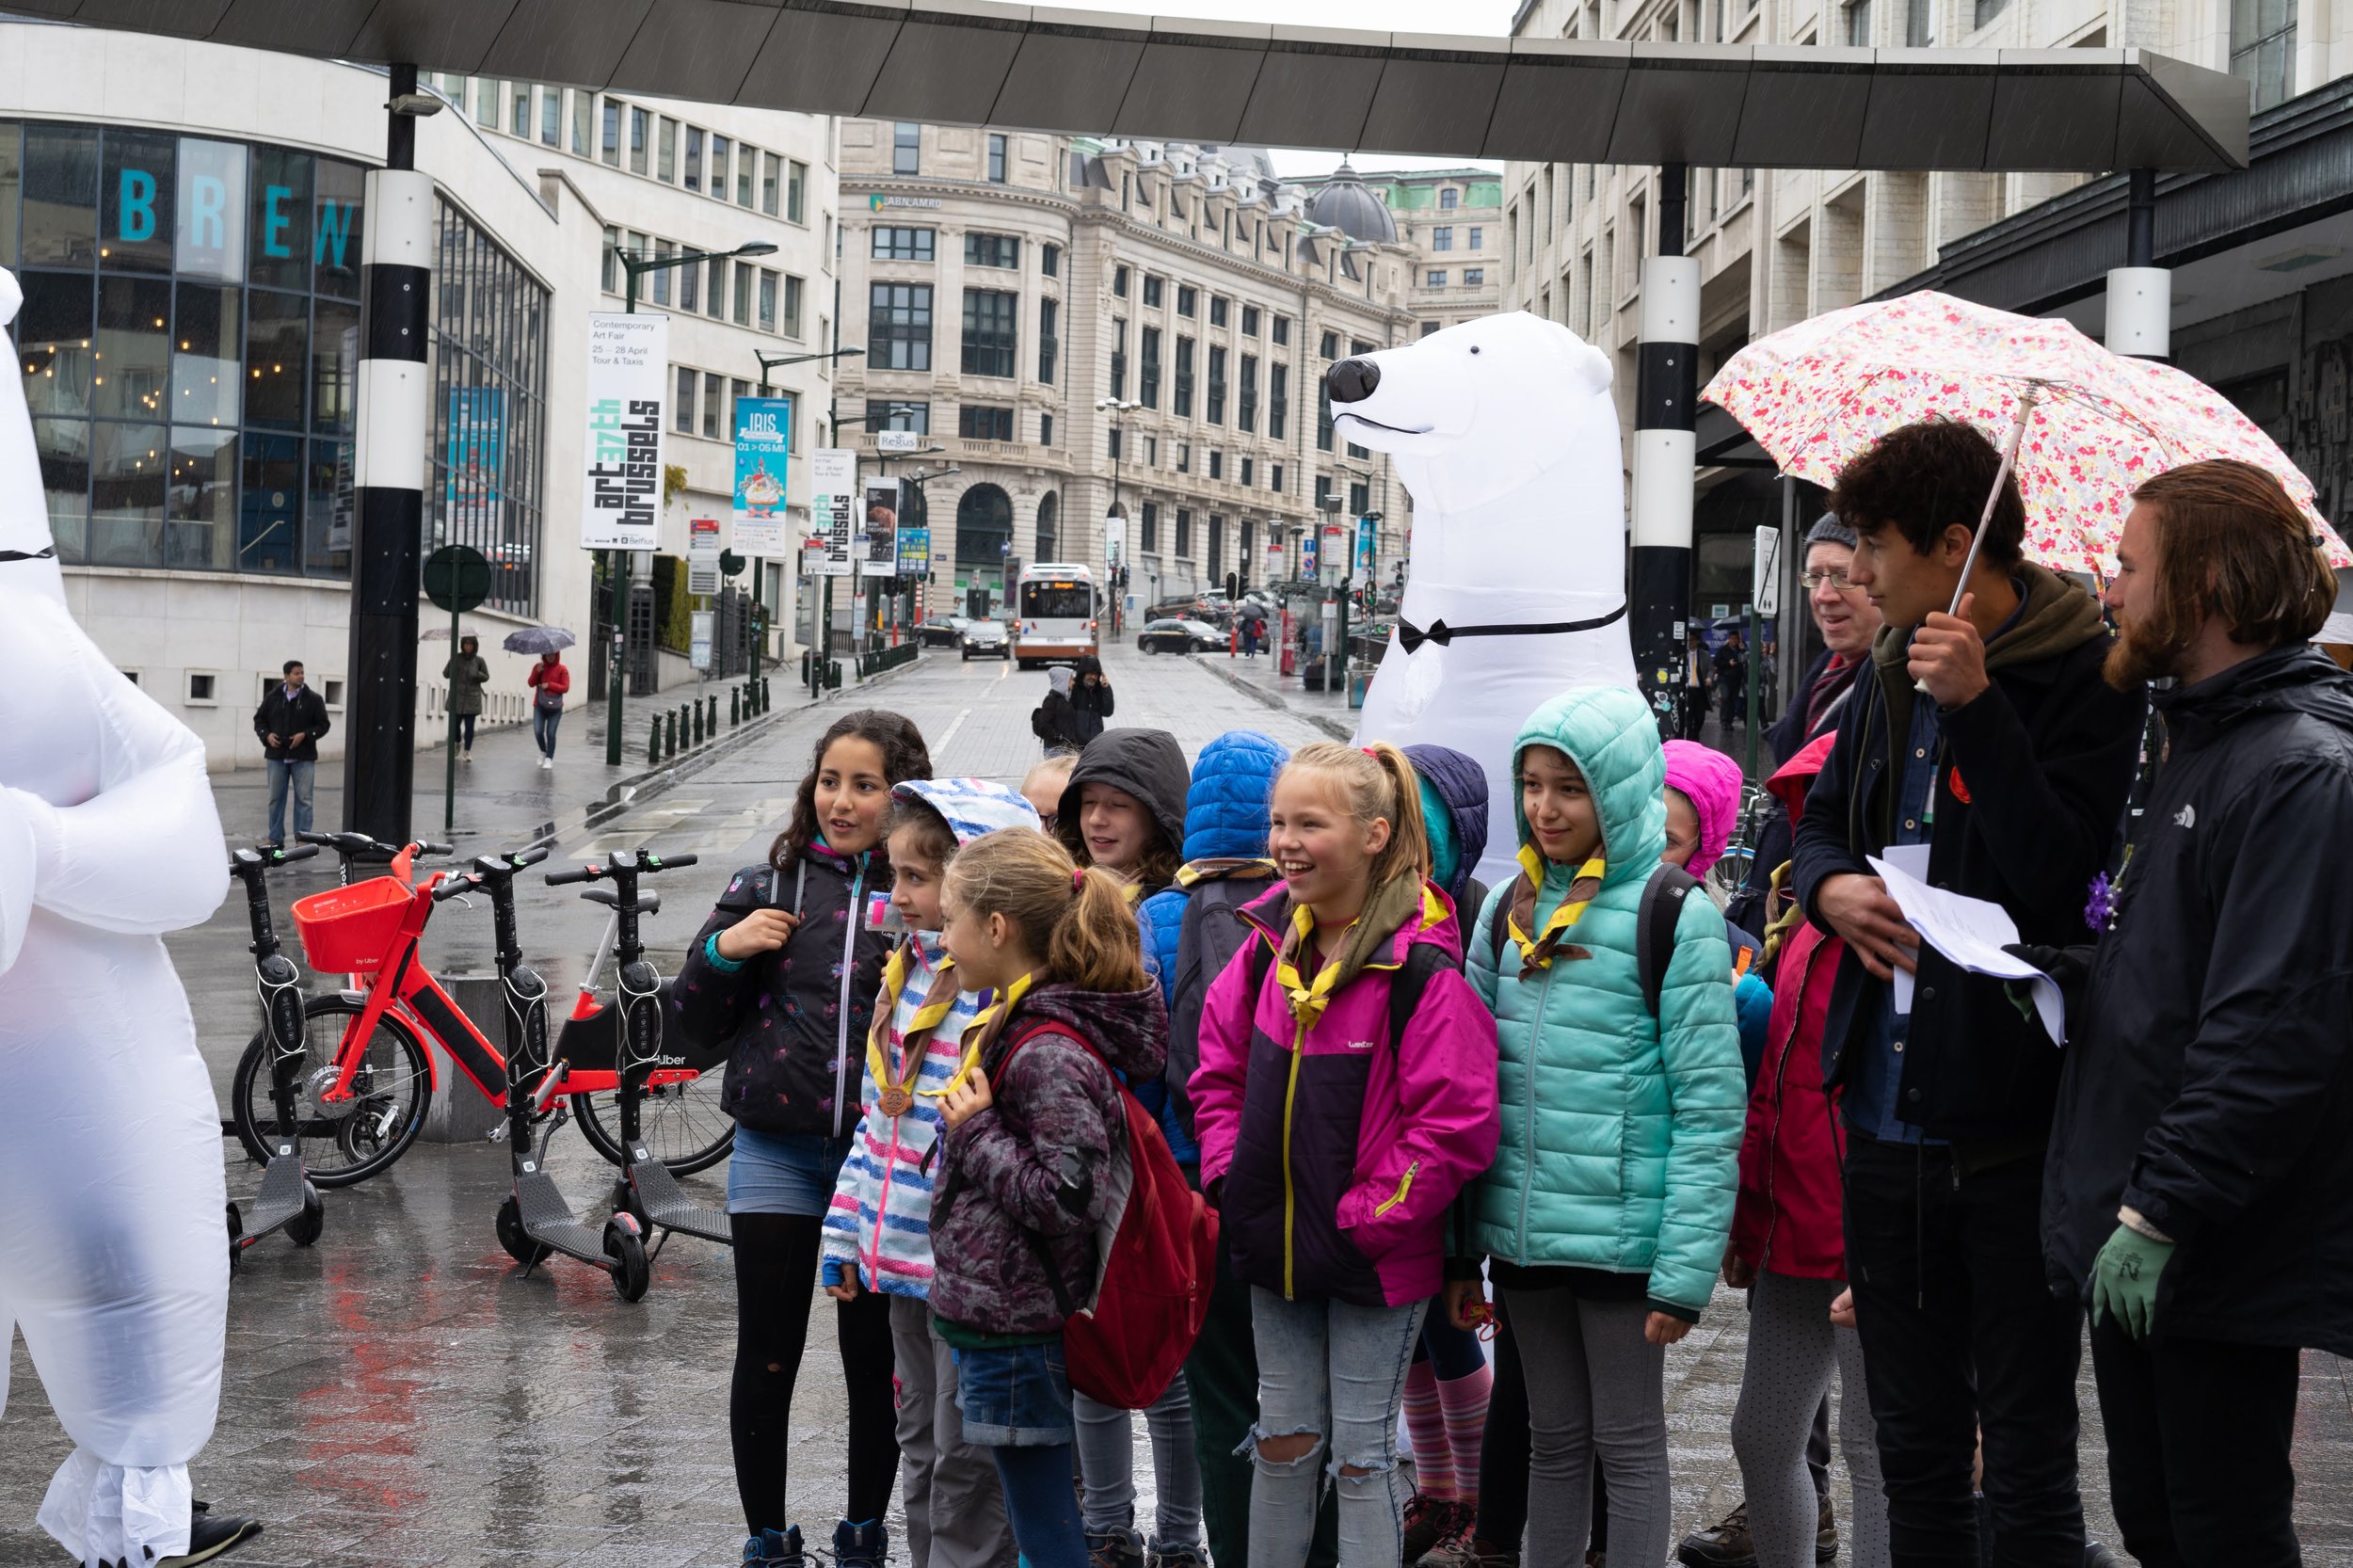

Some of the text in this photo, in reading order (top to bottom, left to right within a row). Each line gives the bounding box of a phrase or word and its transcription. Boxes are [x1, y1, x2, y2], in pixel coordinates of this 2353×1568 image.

[120, 168, 354, 268] BREW
[593, 320, 655, 331] Contemporary
[628, 346, 648, 355] April
[750, 412, 776, 432] IRIS
[737, 442, 749, 451] 01
[882, 436, 915, 447] Regus
